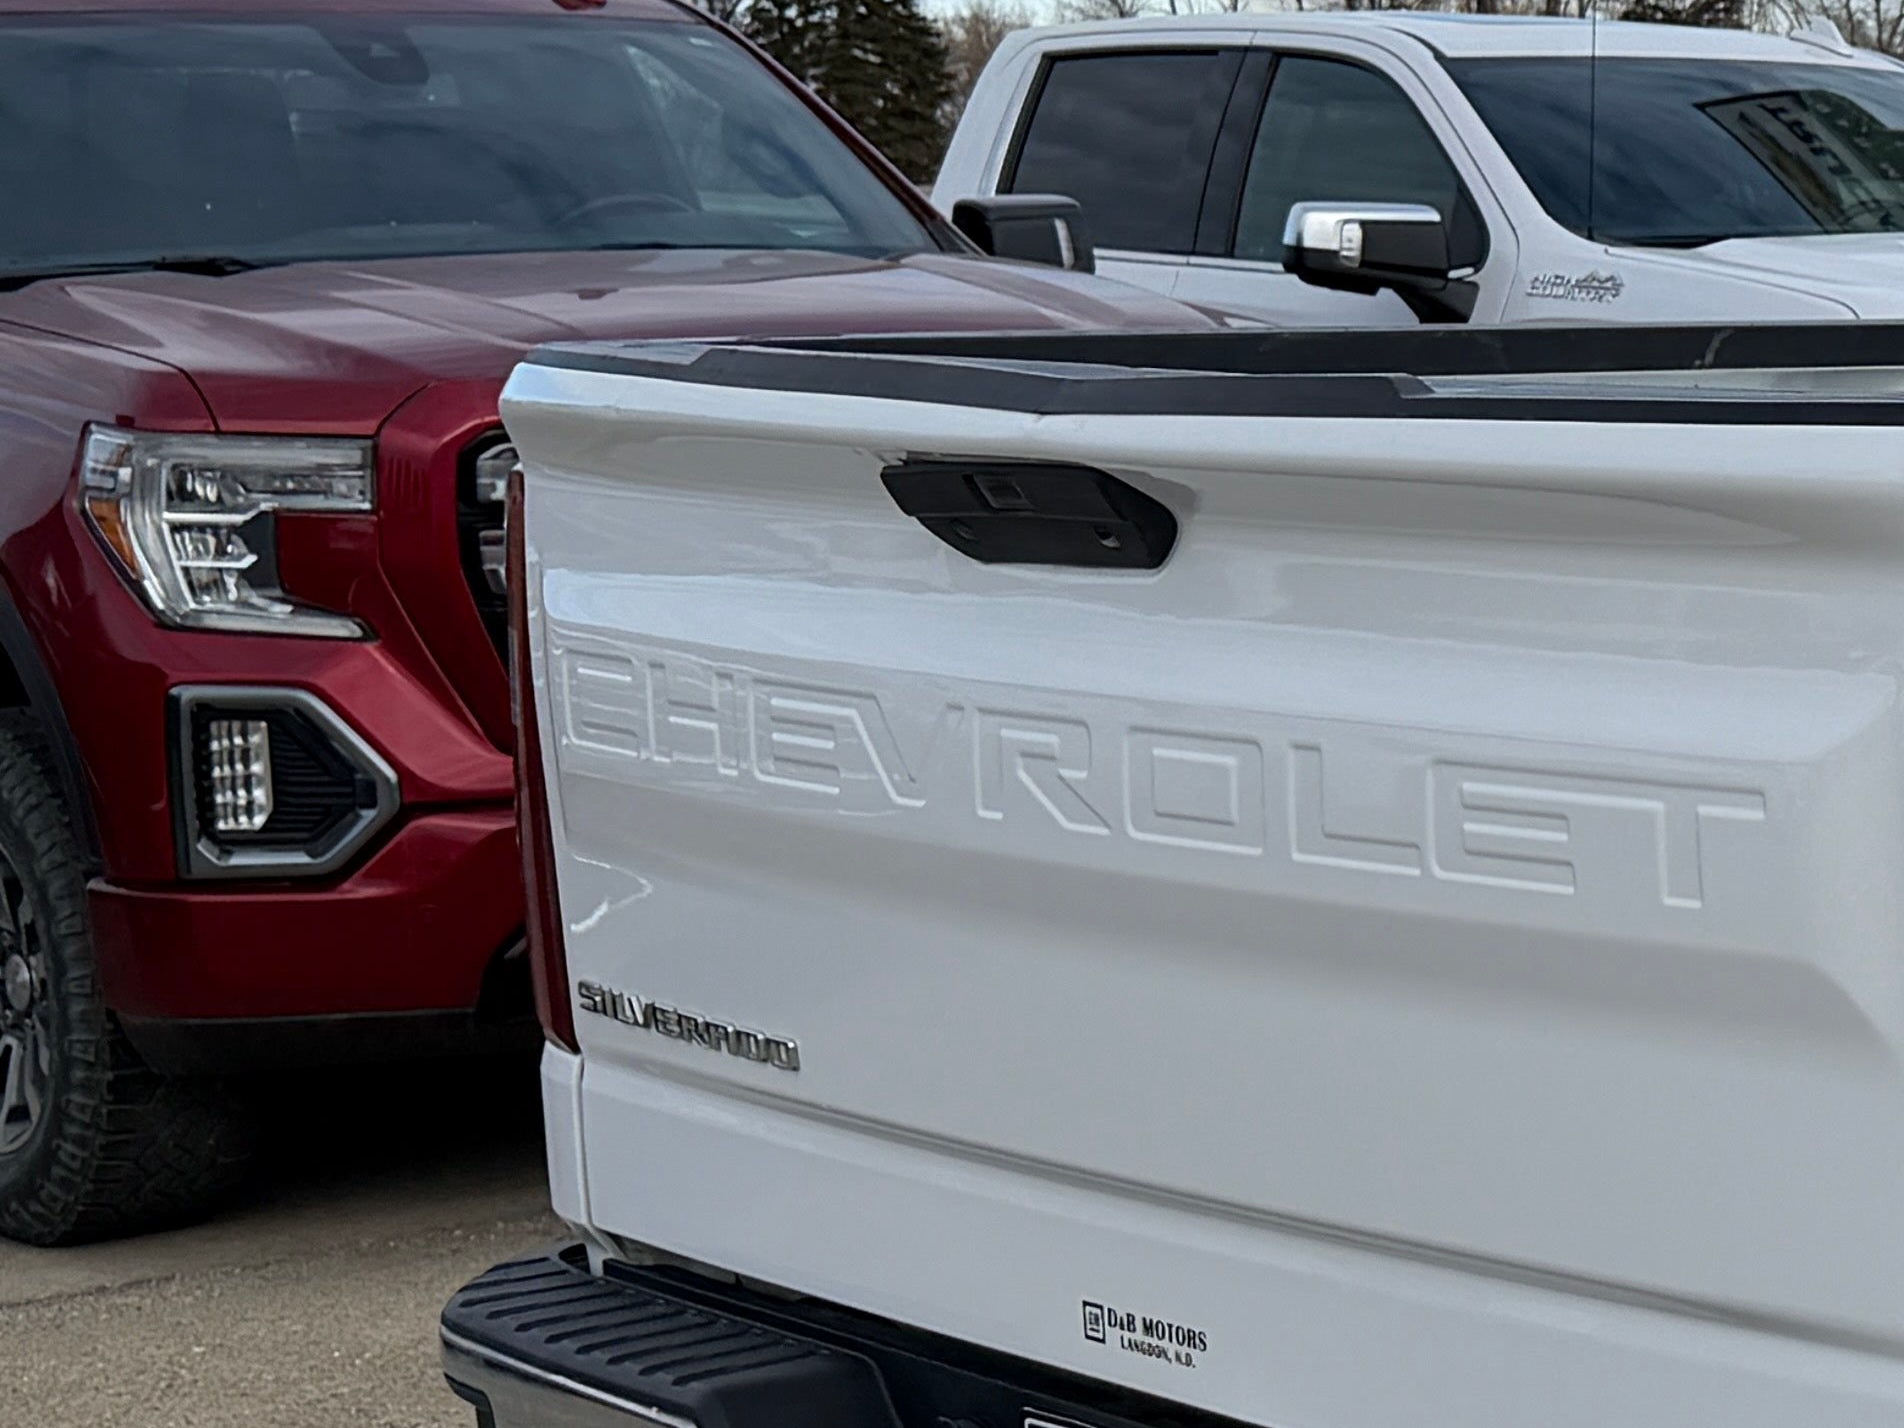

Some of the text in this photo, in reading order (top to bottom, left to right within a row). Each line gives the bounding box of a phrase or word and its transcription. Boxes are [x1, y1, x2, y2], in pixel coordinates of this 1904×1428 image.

[558, 645, 1769, 910] CHEVROLET
[578, 979, 800, 1072] SILVERADO
[1106, 1307, 1208, 1353] D&B MOTORS
